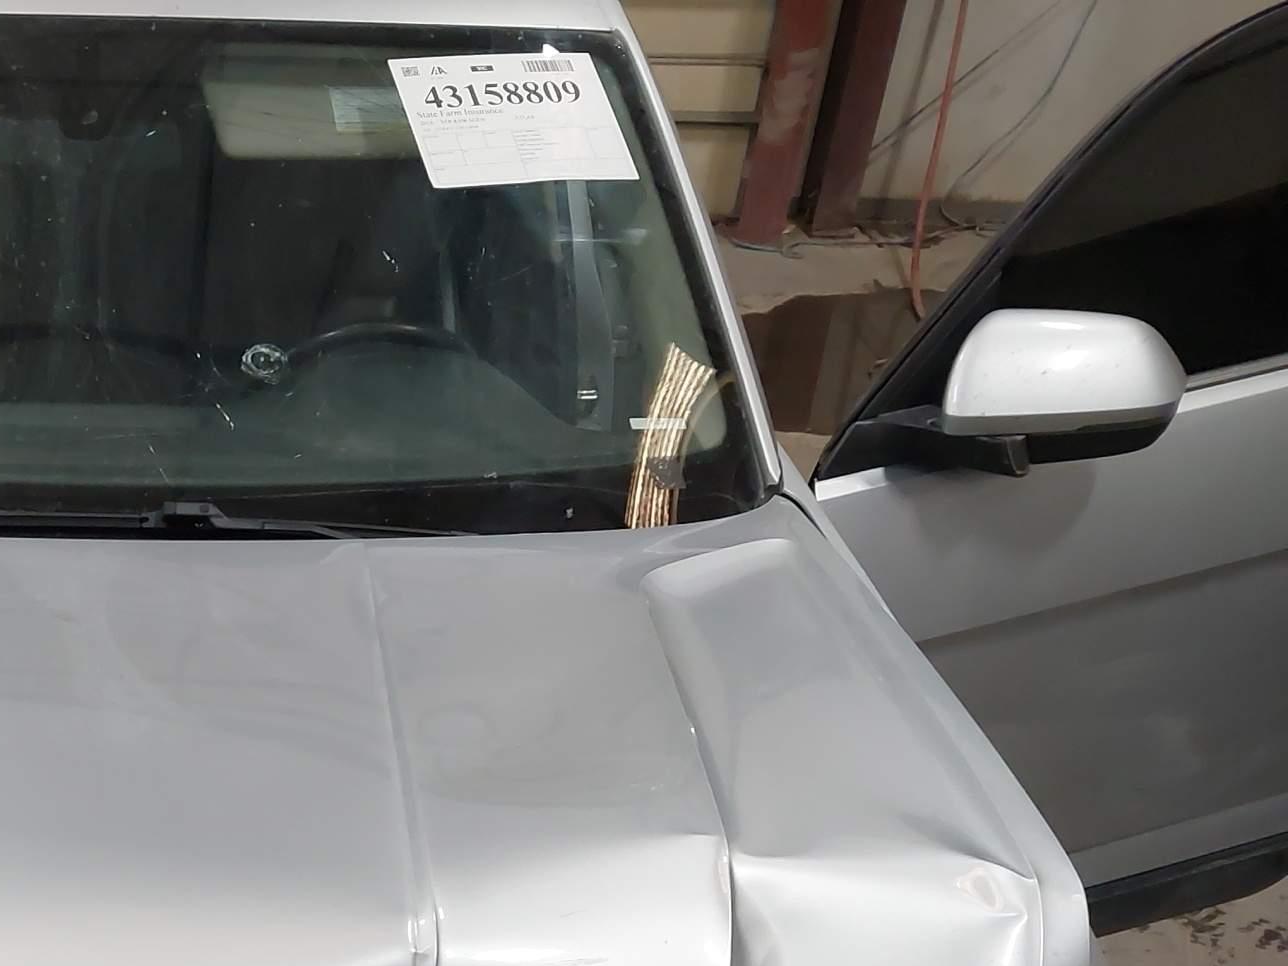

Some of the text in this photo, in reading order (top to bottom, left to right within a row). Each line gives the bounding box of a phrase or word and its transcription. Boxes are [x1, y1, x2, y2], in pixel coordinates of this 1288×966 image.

[424, 80, 581, 108] 43158809
[416, 110, 439, 119] State
[440, 109, 463, 118] Farm
